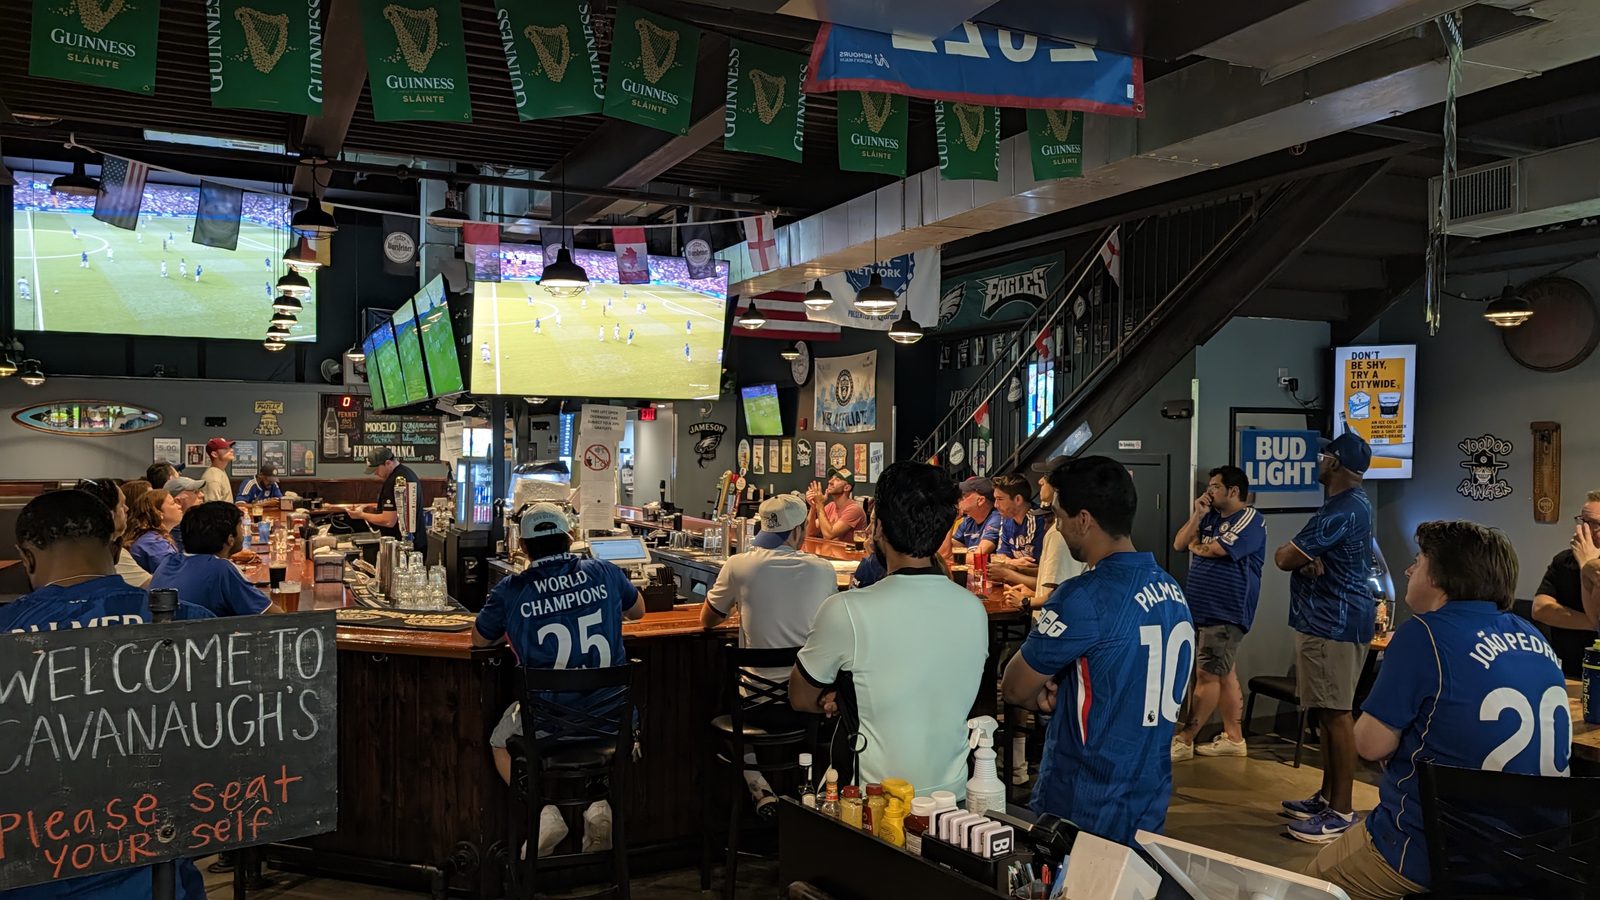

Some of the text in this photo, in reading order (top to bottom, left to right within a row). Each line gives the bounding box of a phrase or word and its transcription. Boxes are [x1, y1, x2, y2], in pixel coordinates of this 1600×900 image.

[51, 28, 136, 57] GUINNESS
[206, 0, 223, 93] GUINNES
[67, 53, 120, 69] SLÁINTE
[497, 8, 527, 108] GUINNESS
[386, 75, 455, 90] GUINNESS
[621, 78, 679, 105] GUINNESS
[724, 48, 740, 138] GUINNESS
[403, 95, 445, 103] SLÁINTE
[631, 99, 668, 114] SLÁINTE
[851, 133, 899, 149] GUINNESS
[934, 99, 949, 170] GUINNE
[862, 150, 892, 159] SLÁINTE
[1041, 144, 1081, 156] GUINNESS
[851, 267, 902, 278] NETORK
[984, 266, 1049, 313] EAGLES
[1351, 351, 1380, 360] DON'T
[1351, 360, 1387, 370] BE SHY,
[1351, 370, 1378, 379] TRY A
[342, 396, 351, 407] 0
[641, 408, 655, 420] EXIT
[365, 422, 396, 432] MODELO
[690, 424, 725, 434] JAMESON
[386, 445, 415, 457] RANCA
[1255, 436, 1306, 460] BUD
[1458, 435, 1512, 455] VOODOO
[1245, 461, 1315, 486] LIGHT
[1458, 480, 1512, 500] RANGER
[534, 570, 588, 594] WORLD
[520, 584, 608, 618] CHAMPIONS
[537, 608, 612, 670] 25
[1469, 630, 1509, 670] JOÃO
[0, 627, 324, 704] WELCOME TO
[1139, 621, 1195, 728] 10
[1480, 686, 1573, 778] 20
[0, 765, 302, 858] Please seat
[188, 806, 273, 849] self
